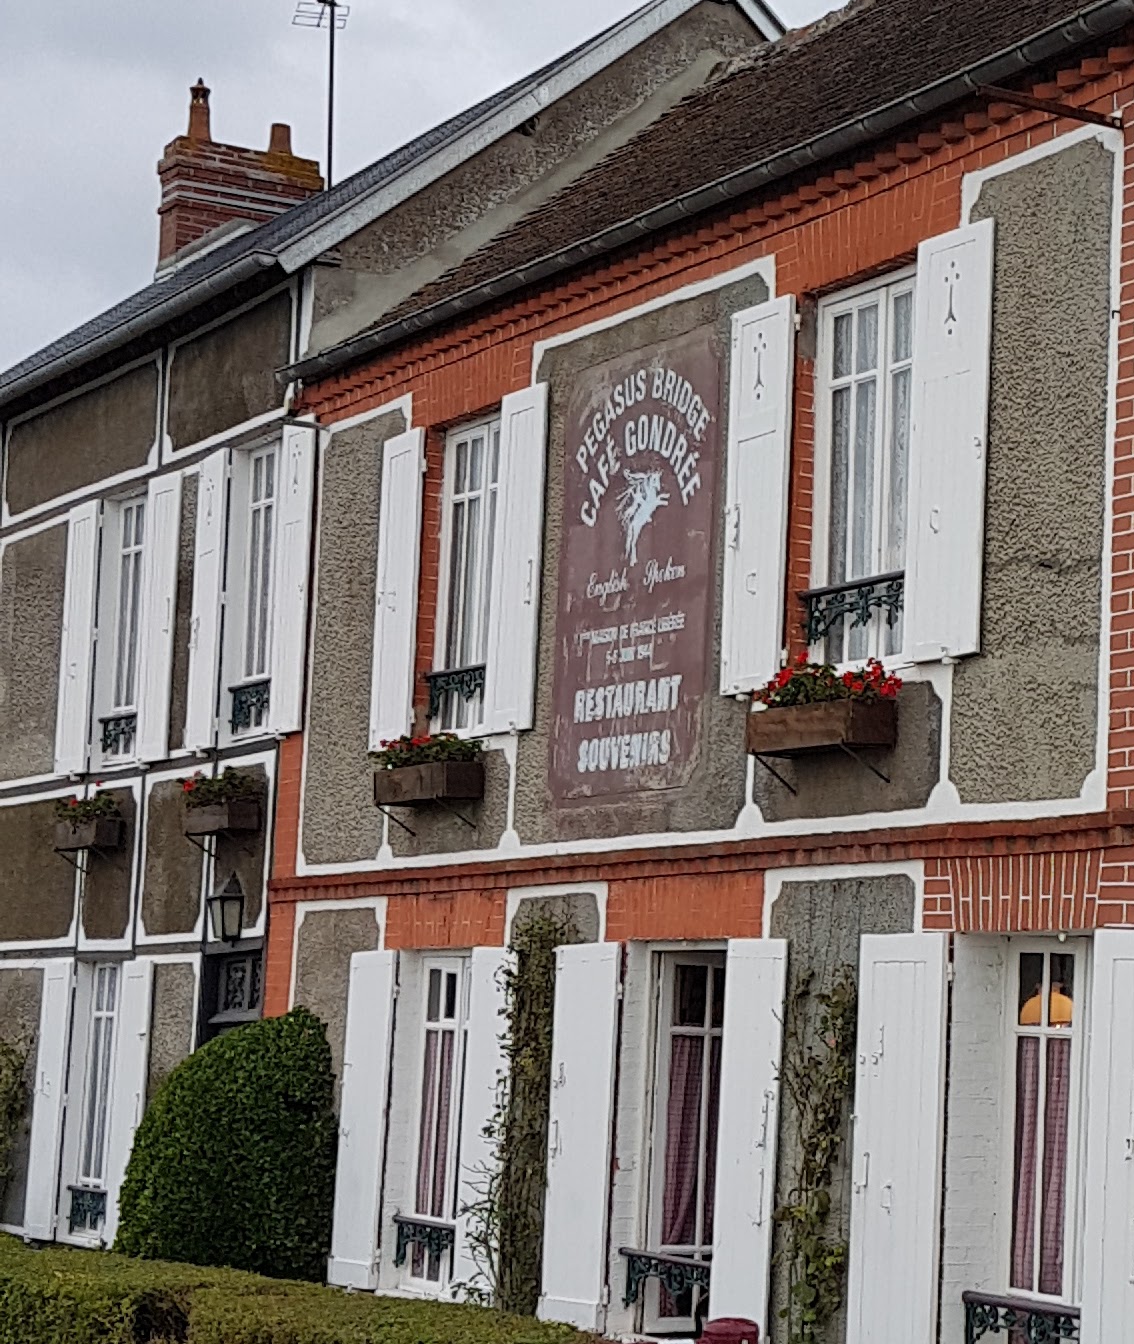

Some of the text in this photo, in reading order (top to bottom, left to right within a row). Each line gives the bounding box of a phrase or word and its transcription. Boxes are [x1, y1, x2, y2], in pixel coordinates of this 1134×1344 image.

[576, 366, 711, 474] PEGASUS BRIDGE
[580, 414, 702, 528] CAFÉ GONDRÉE
[586, 556, 686, 605] English Spoken
[574, 674, 683, 723] RESTAURANT
[577, 729, 671, 773] SOUVENIRS
